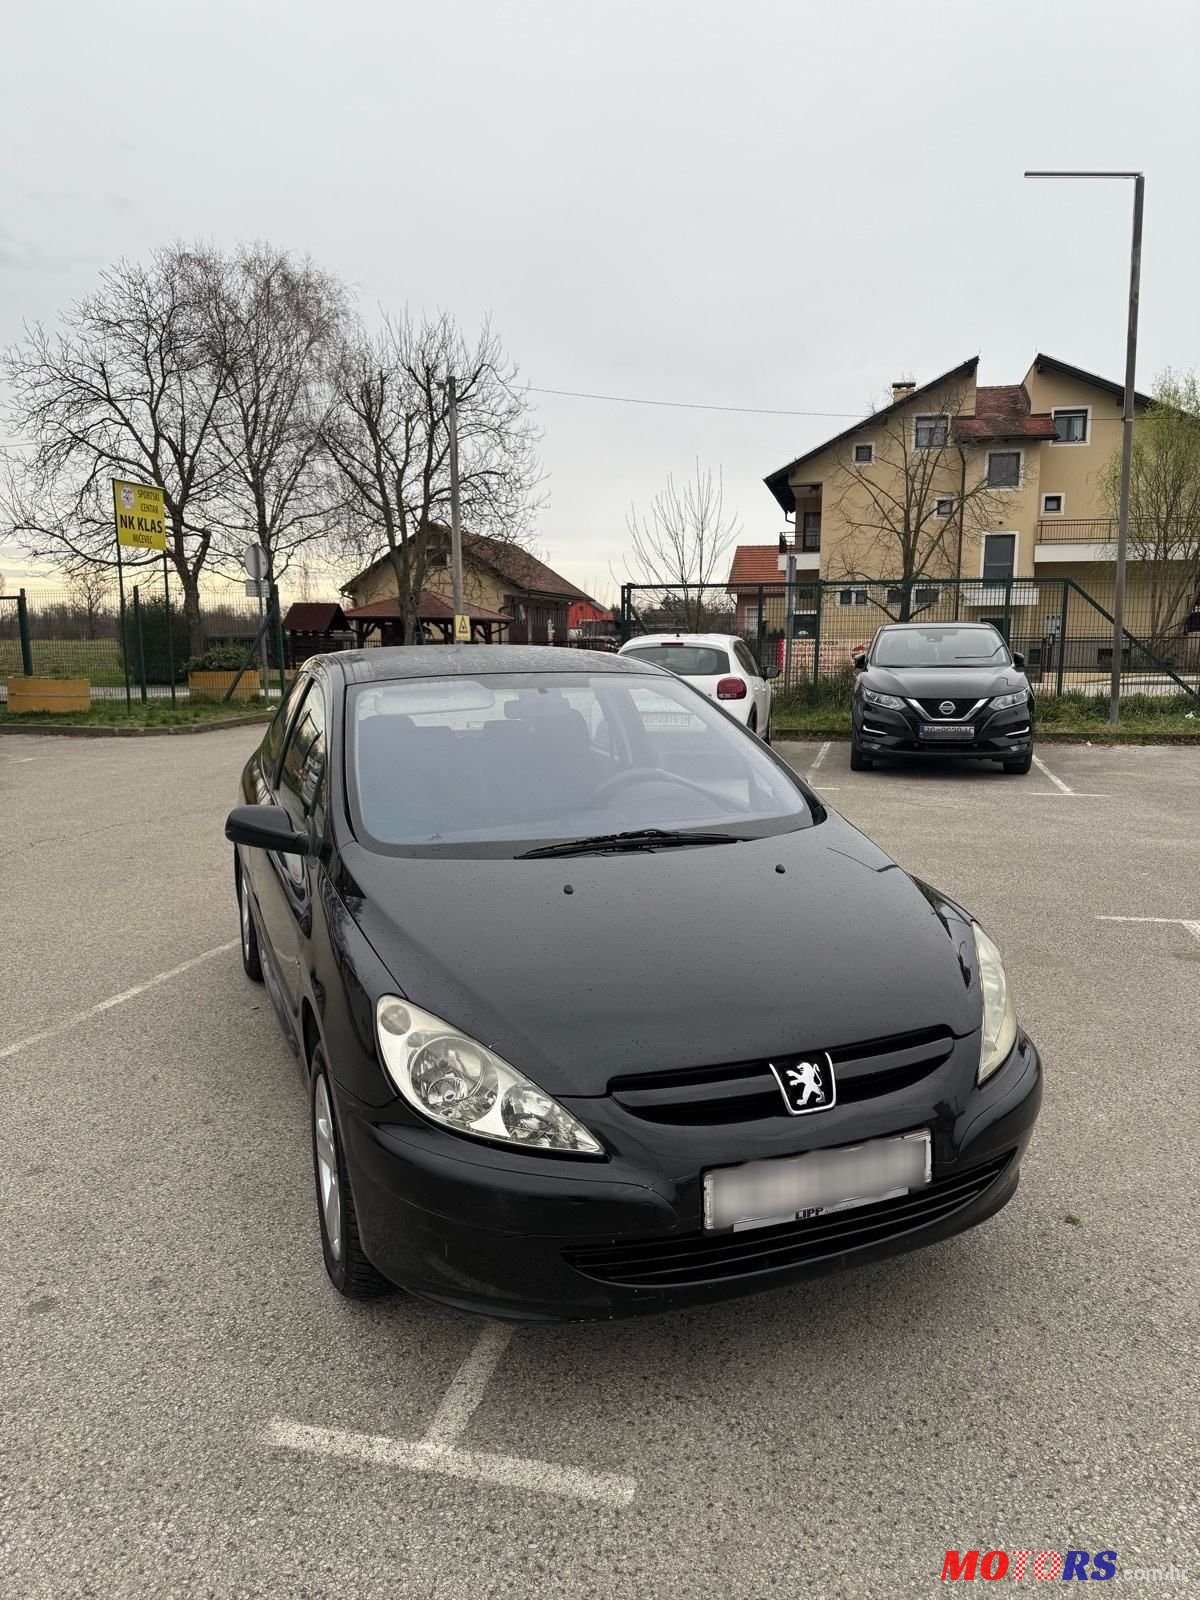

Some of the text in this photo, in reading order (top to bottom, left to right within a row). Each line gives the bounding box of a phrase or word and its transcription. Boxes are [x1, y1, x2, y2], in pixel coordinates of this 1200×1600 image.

[137, 489, 160, 501] SPORTSKI
[141, 503, 159, 513] CENTAR
[120, 514, 163, 534] NK KLAS
